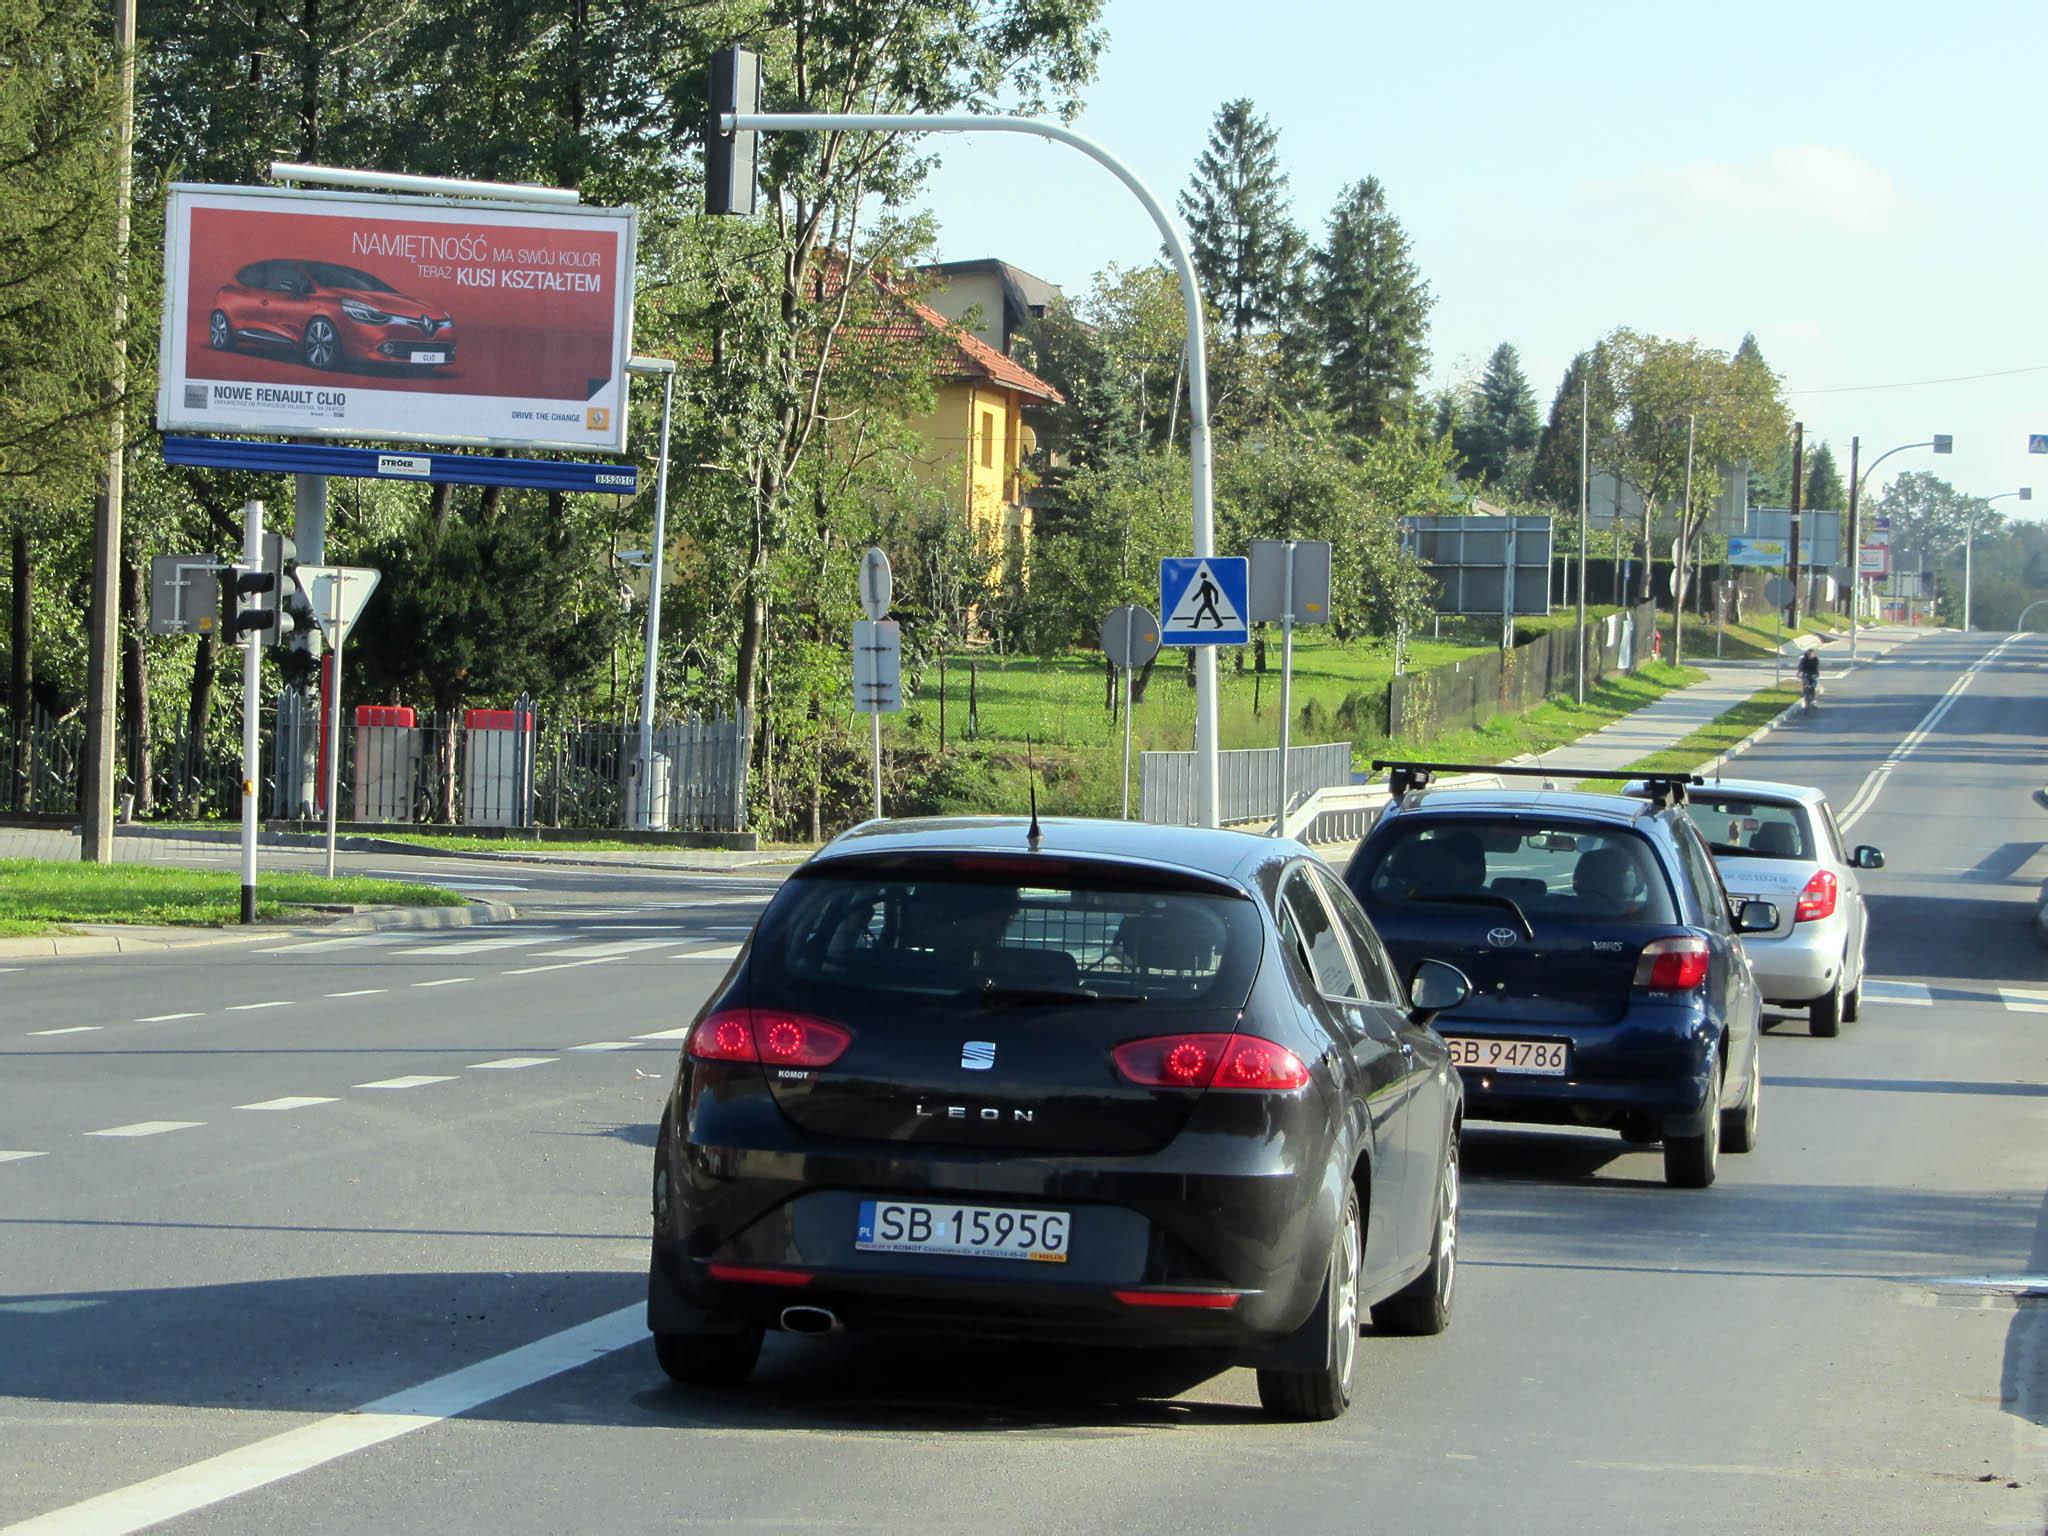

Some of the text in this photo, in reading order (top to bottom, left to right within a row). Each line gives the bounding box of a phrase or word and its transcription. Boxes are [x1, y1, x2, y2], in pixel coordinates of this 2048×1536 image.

[352, 231, 601, 267] NAMIĘTNOŚĆ MA SWÓJ KOLOR
[417, 264, 601, 293] TERAZ KUSI KSZTAŁTEM
[213, 386, 253, 401] NOWE
[256, 388, 313, 404] RENAULT
[316, 391, 346, 406] CLIO
[511, 410, 581, 423] DRIVE THE CHANGE
[1447, 1041, 1562, 1067] SB 94786
[778, 1070, 809, 1079] KOMOT
[916, 1104, 1033, 1122] LEON
[858, 1227, 873, 1237] PL
[881, 1206, 1064, 1251] SB 1595G
